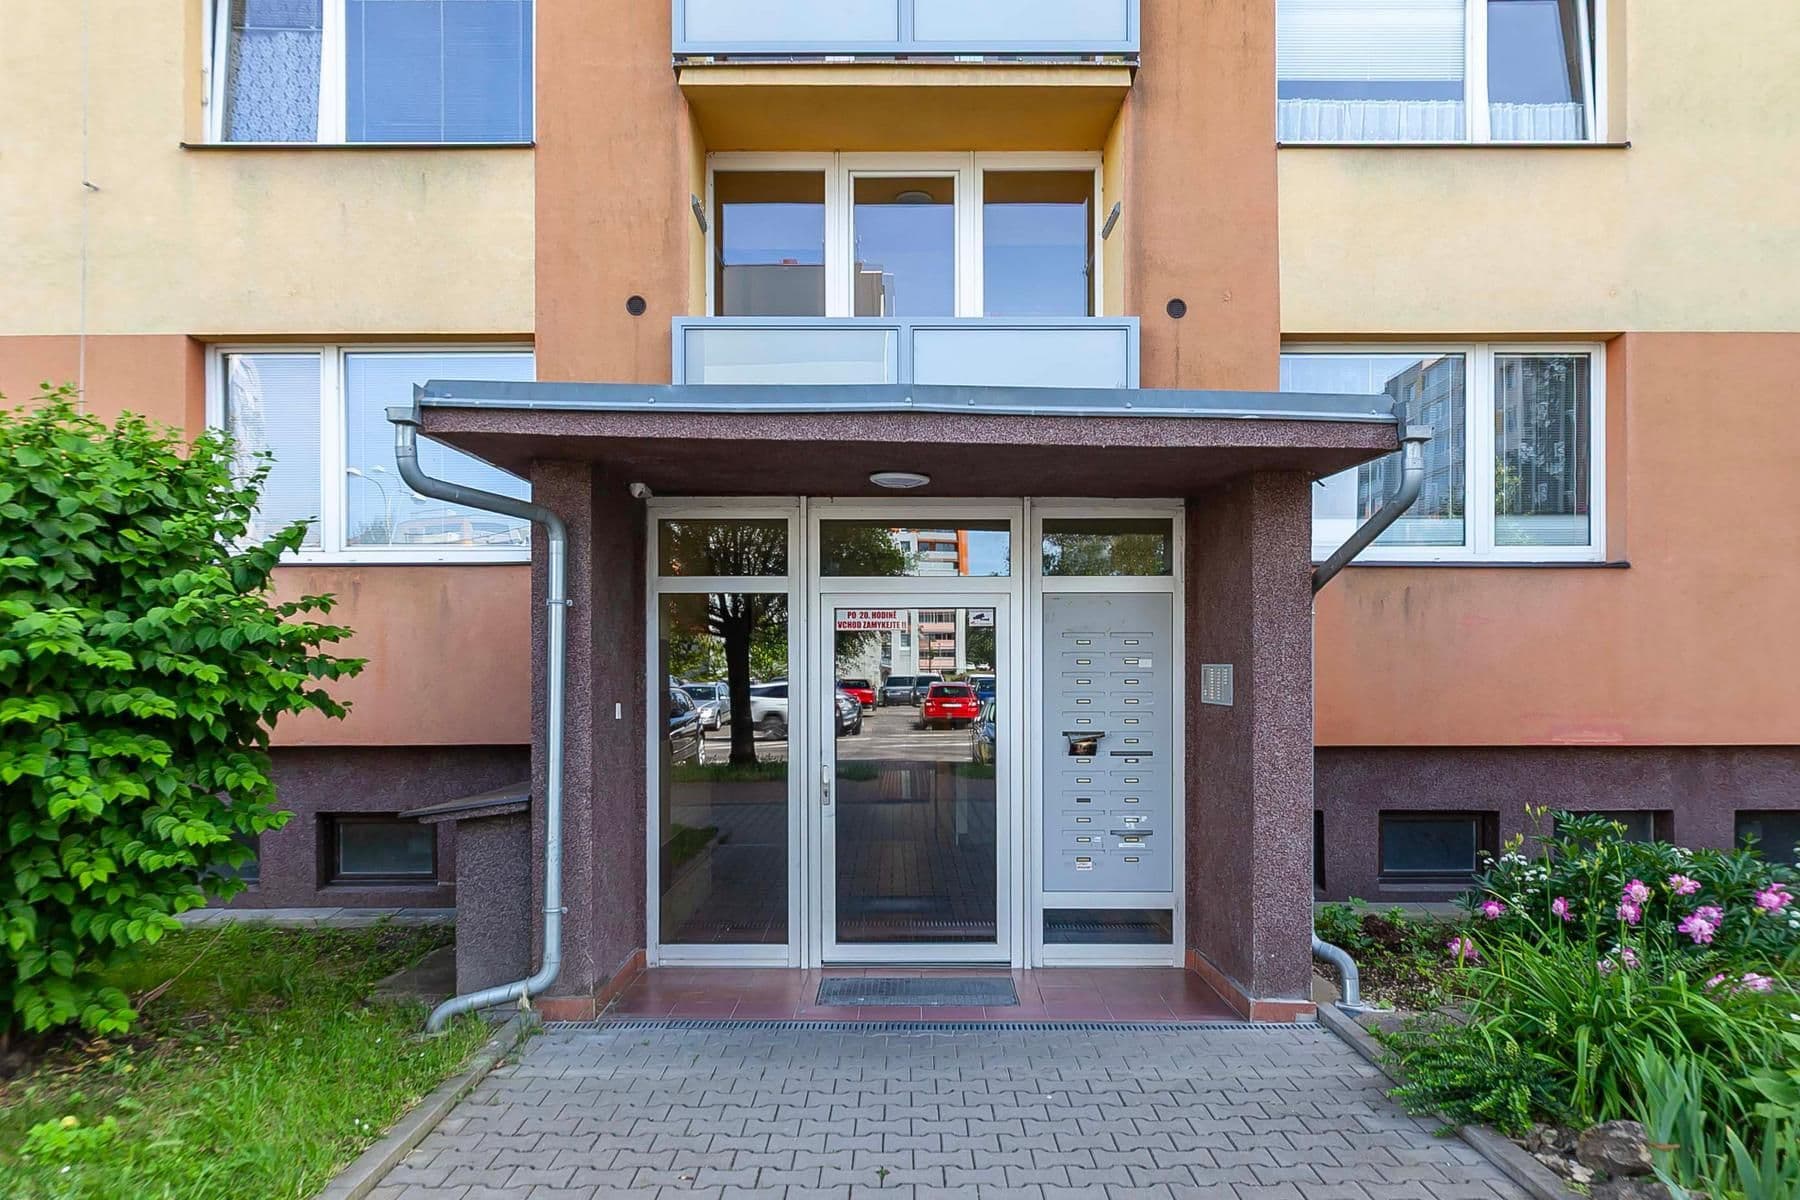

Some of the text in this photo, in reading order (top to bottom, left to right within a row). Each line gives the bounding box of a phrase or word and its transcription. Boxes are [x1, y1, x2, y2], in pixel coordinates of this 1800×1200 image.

[847, 611, 857, 619] PO
[837, 621, 862, 629] VCHOD
[863, 621, 900, 629] ZAMYKEJTE
